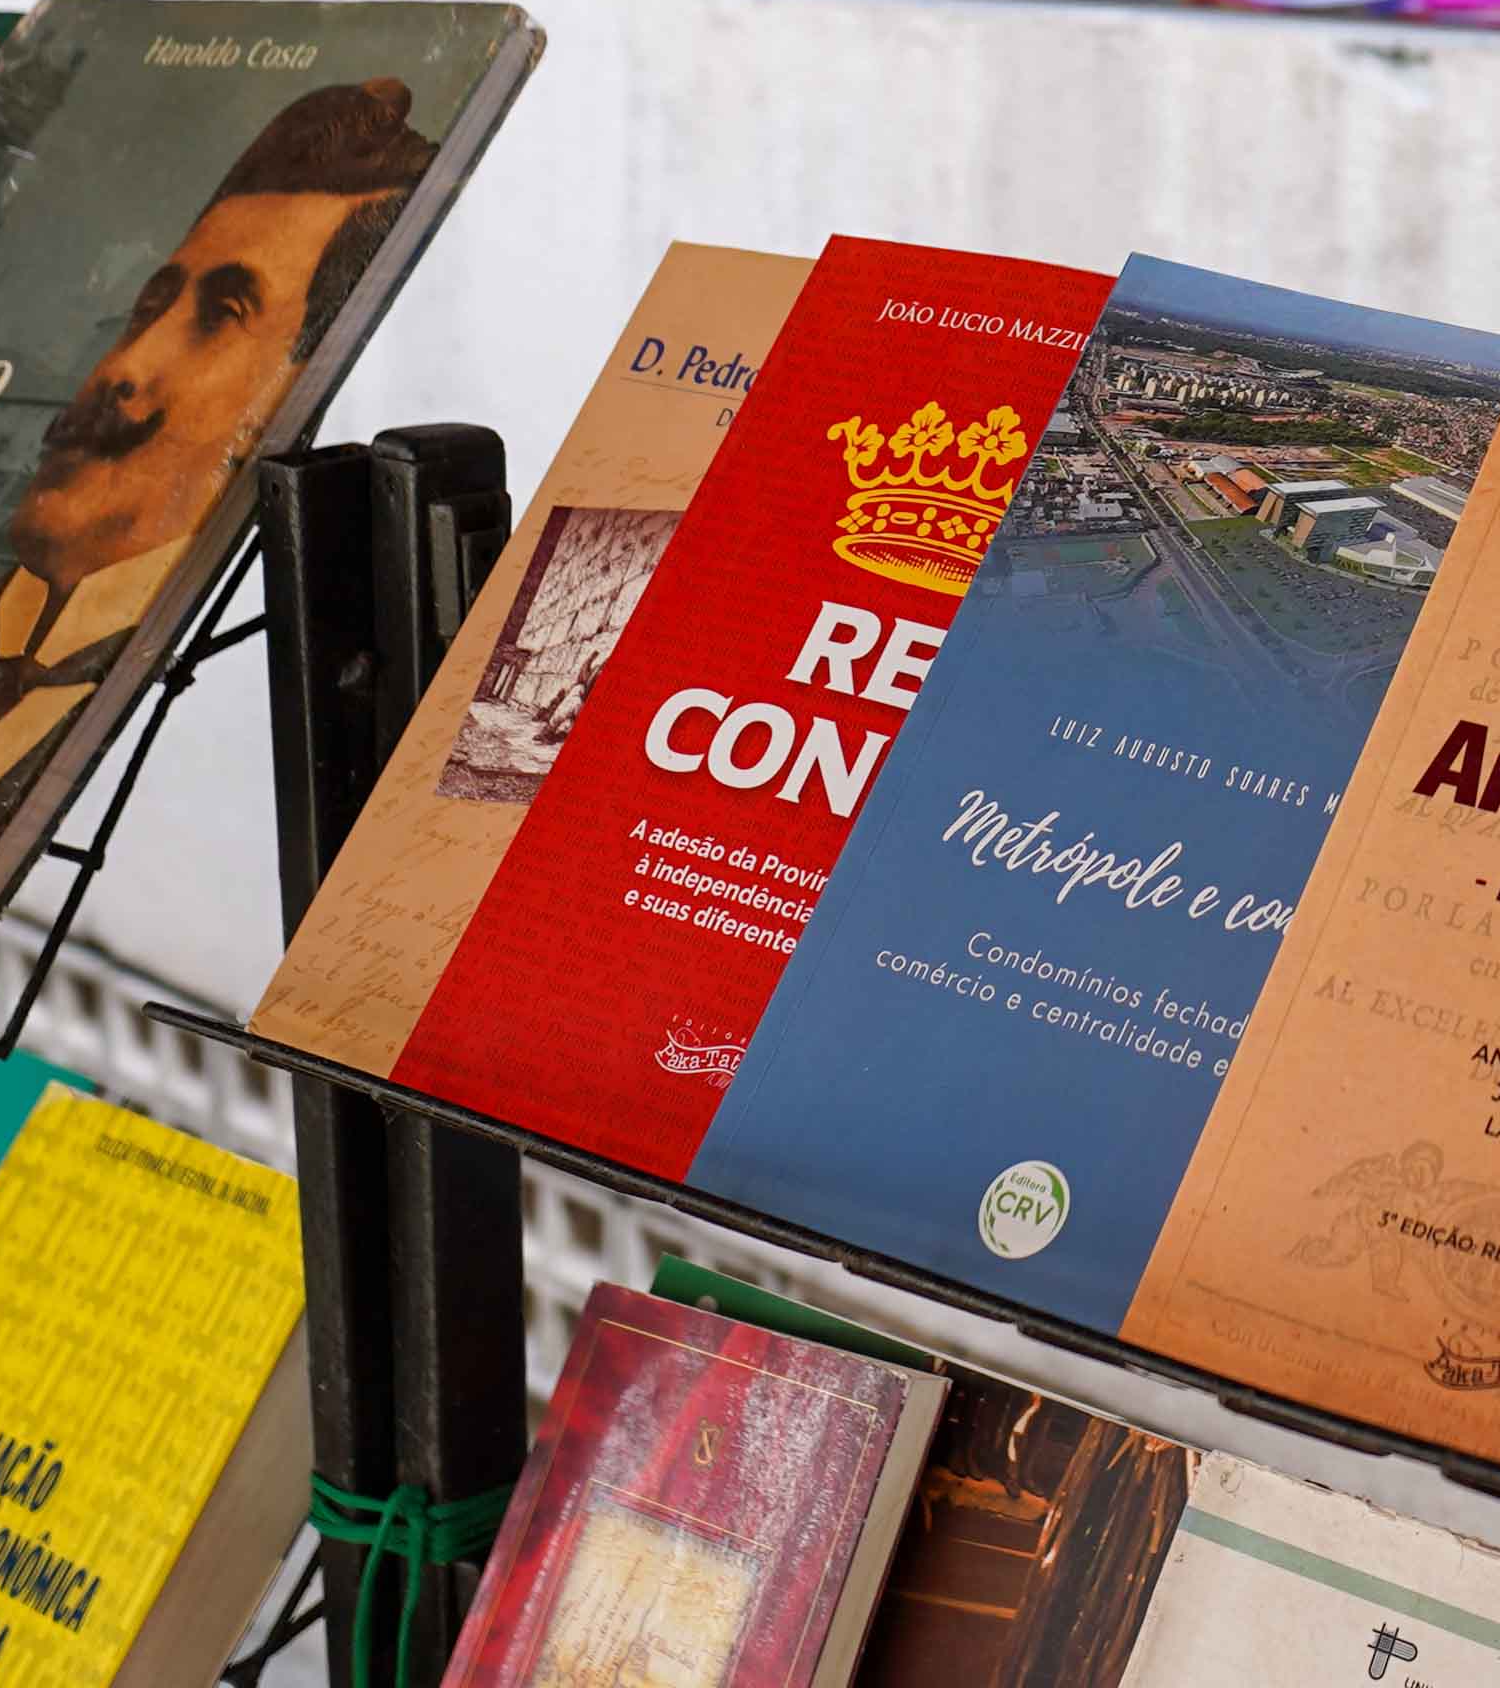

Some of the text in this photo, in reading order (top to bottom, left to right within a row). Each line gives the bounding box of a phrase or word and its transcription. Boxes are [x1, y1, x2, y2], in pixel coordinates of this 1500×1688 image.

[143, 34, 320, 70] Haroldo Costa
[877, 298, 935, 325] JOÃO
[630, 337, 664, 376] D.
[785, 600, 948, 711] RE
[644, 687, 891, 818] CON
[1050, 716, 1102, 748] LUIZ
[1114, 735, 1212, 779] AUGUSTO
[1226, 766, 1310, 808] SOARES
[629, 818, 647, 840] A
[648, 827, 725, 861] adesão
[728, 846, 757, 872] da
[942, 788, 1184, 910] Metrópole
[1188, 885, 1221, 919] e
[624, 890, 798, 955] e suas diferente
[635, 853, 815, 924] à independência
[967, 931, 1144, 1009] Condomínios
[876, 948, 996, 1002] comércio
[1006, 991, 1022, 1011] e
[1032, 997, 1203, 1069] centralidade
[996, 1190, 1054, 1225] CRV
